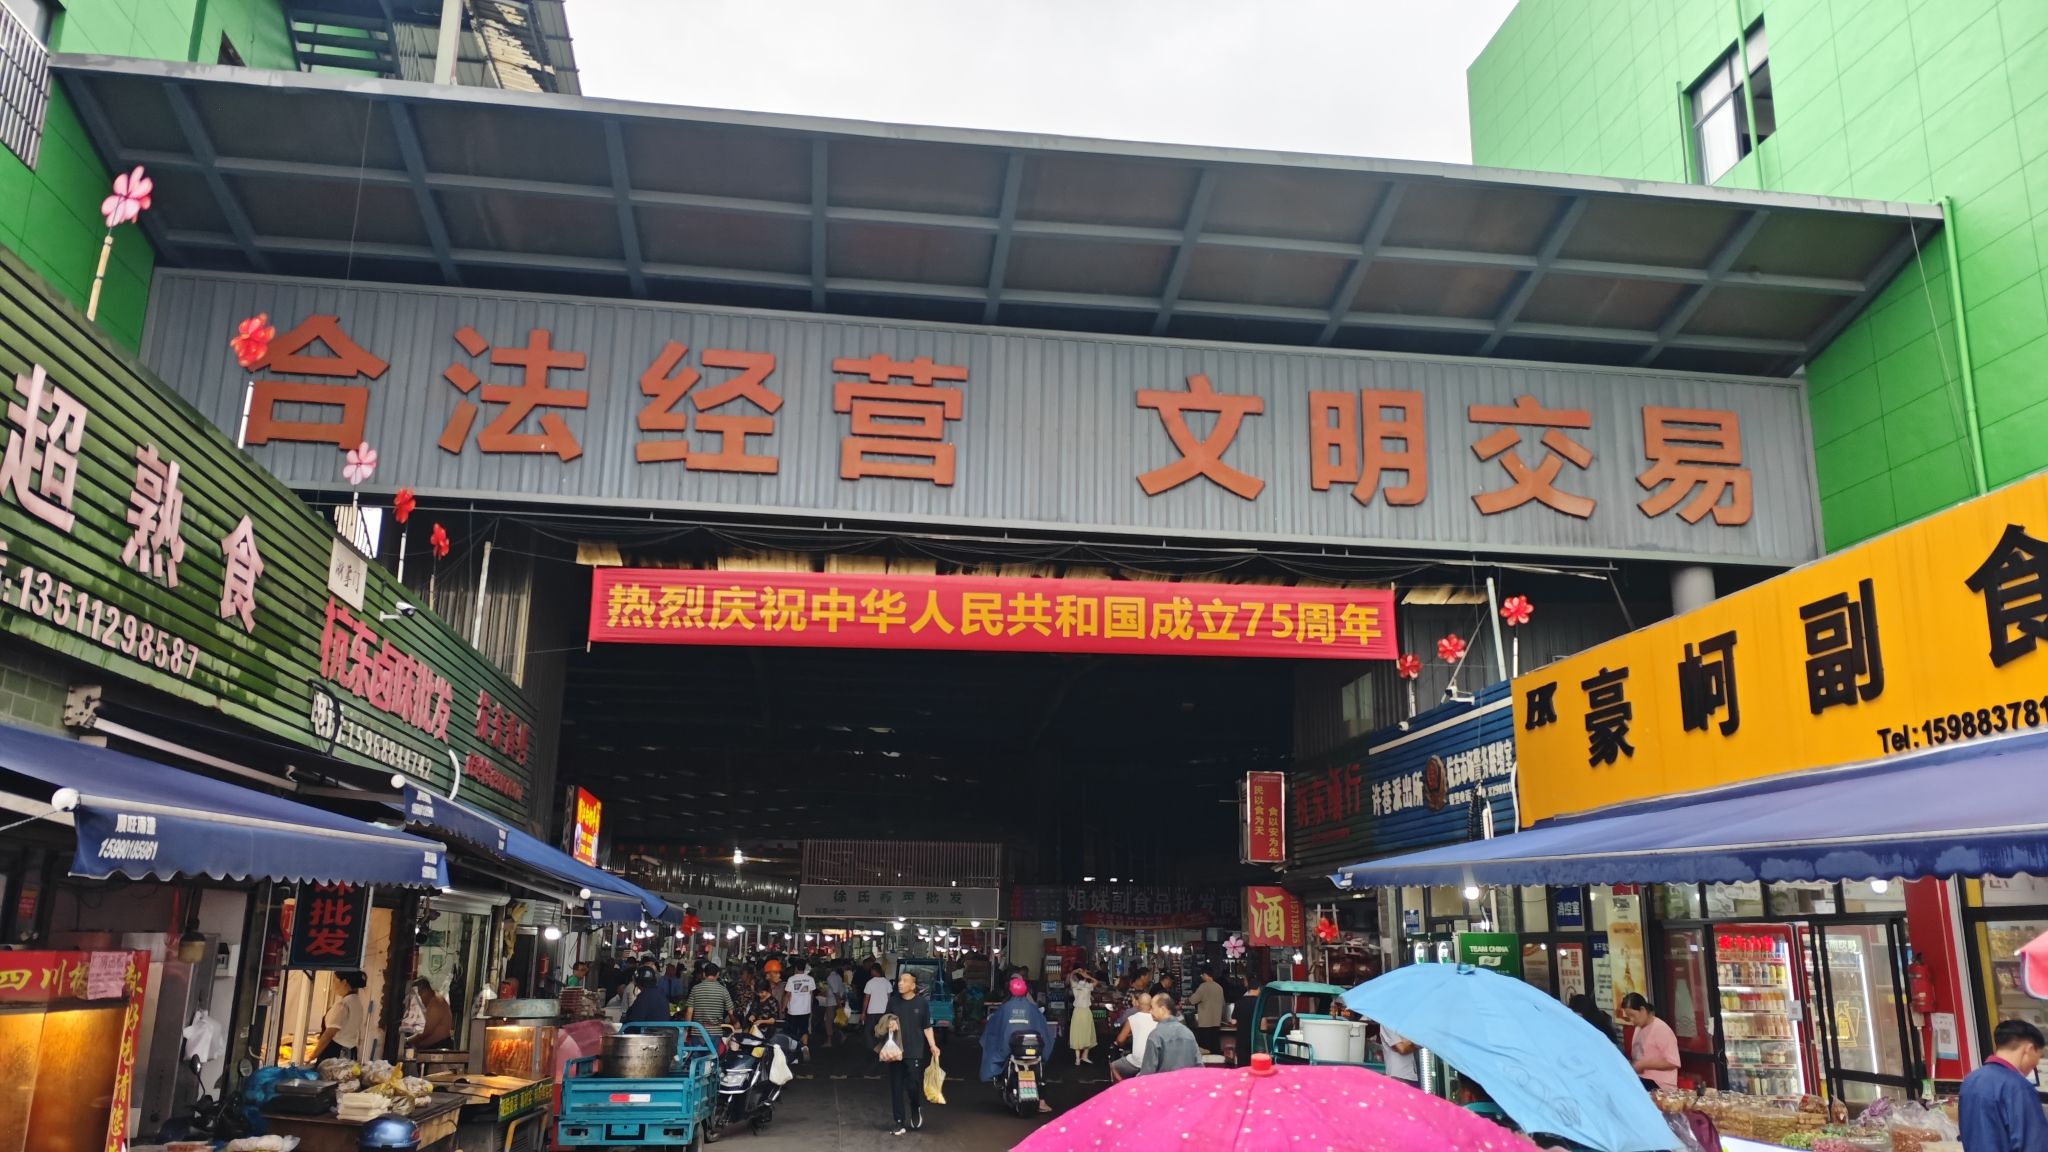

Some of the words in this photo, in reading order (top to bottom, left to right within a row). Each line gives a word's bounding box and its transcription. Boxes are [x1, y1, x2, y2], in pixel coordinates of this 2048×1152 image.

[246, 314, 968, 485] 合法经营
[1136, 374, 1754, 526] 文明交易
[606, 583, 1382, 645] 热烈庆祝中华人民共和国成立75周年
[1254, 785, 1264, 836] 民以食为天
[1268, 806, 1280, 857] 食以安为先
[1250, 890, 1286, 942] 酒
[1469, 945, 1488, 953] TEAM
[1489, 945, 1509, 953] CHINA
